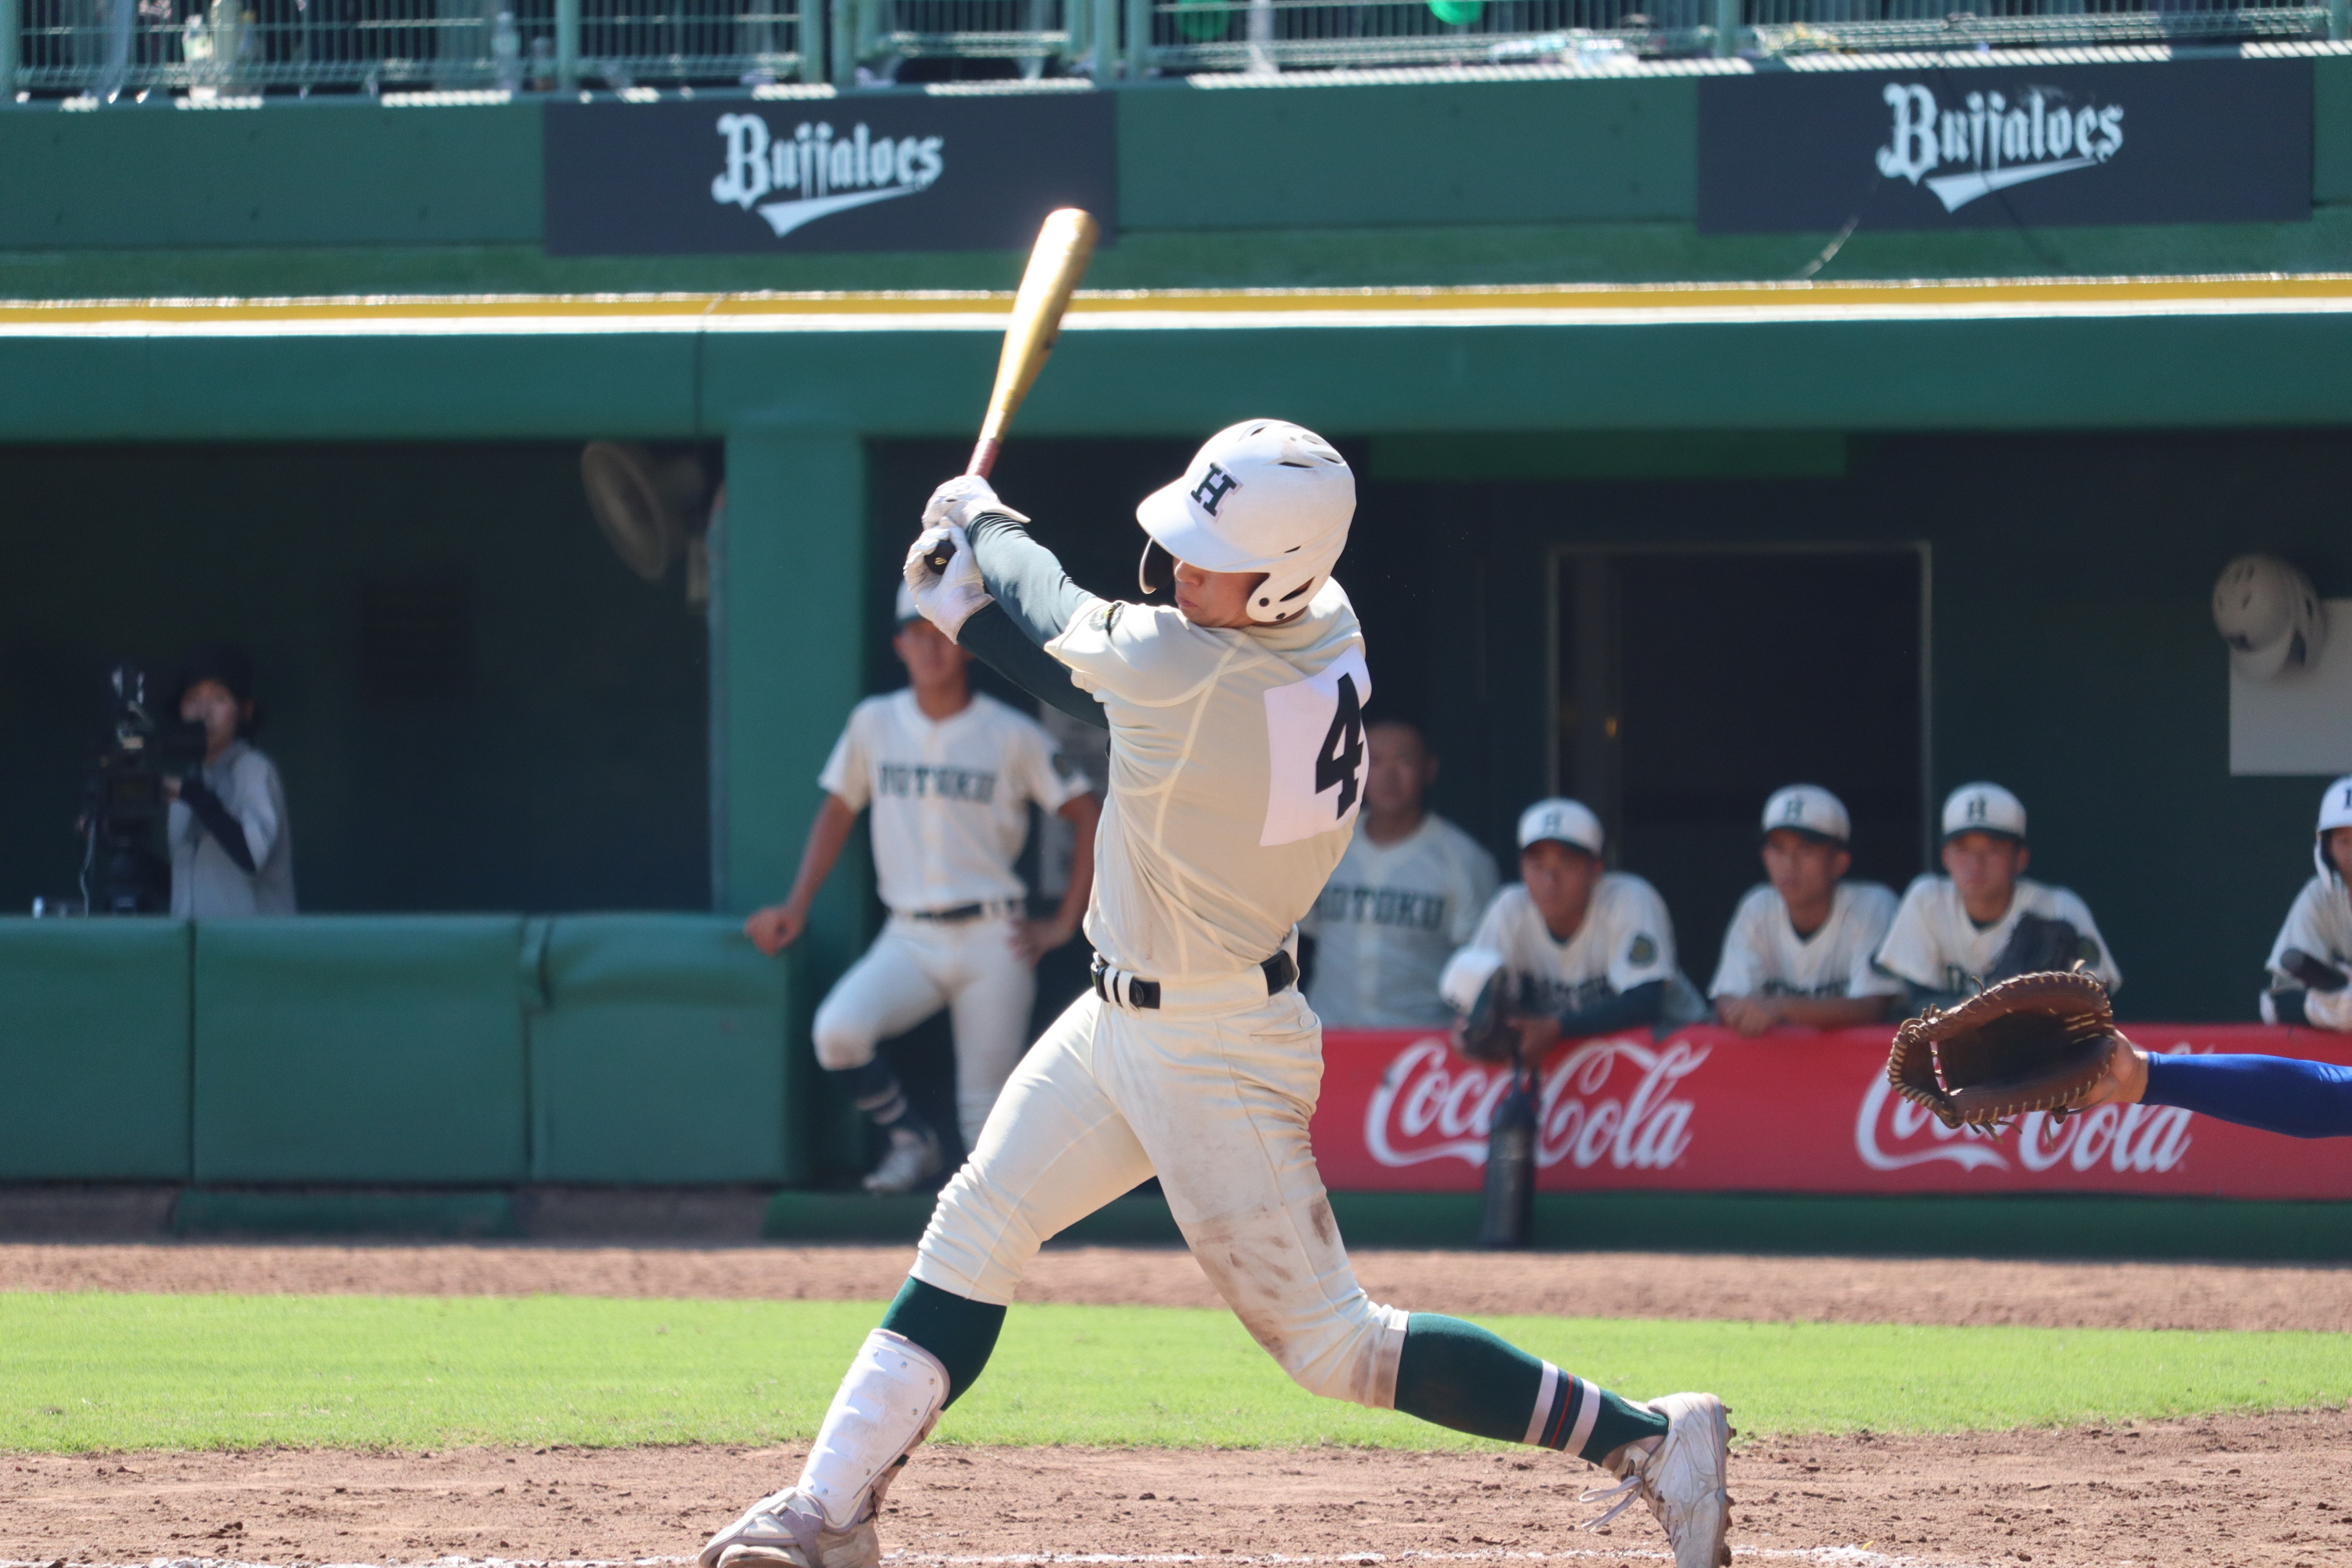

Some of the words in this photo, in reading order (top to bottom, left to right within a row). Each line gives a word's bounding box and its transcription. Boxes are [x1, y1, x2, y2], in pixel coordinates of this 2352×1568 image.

[711, 113, 944, 212] Buffaloes
[1875, 82, 2125, 187] Buffaloes
[1190, 460, 1238, 518] H
[1315, 671, 1365, 822] 4
